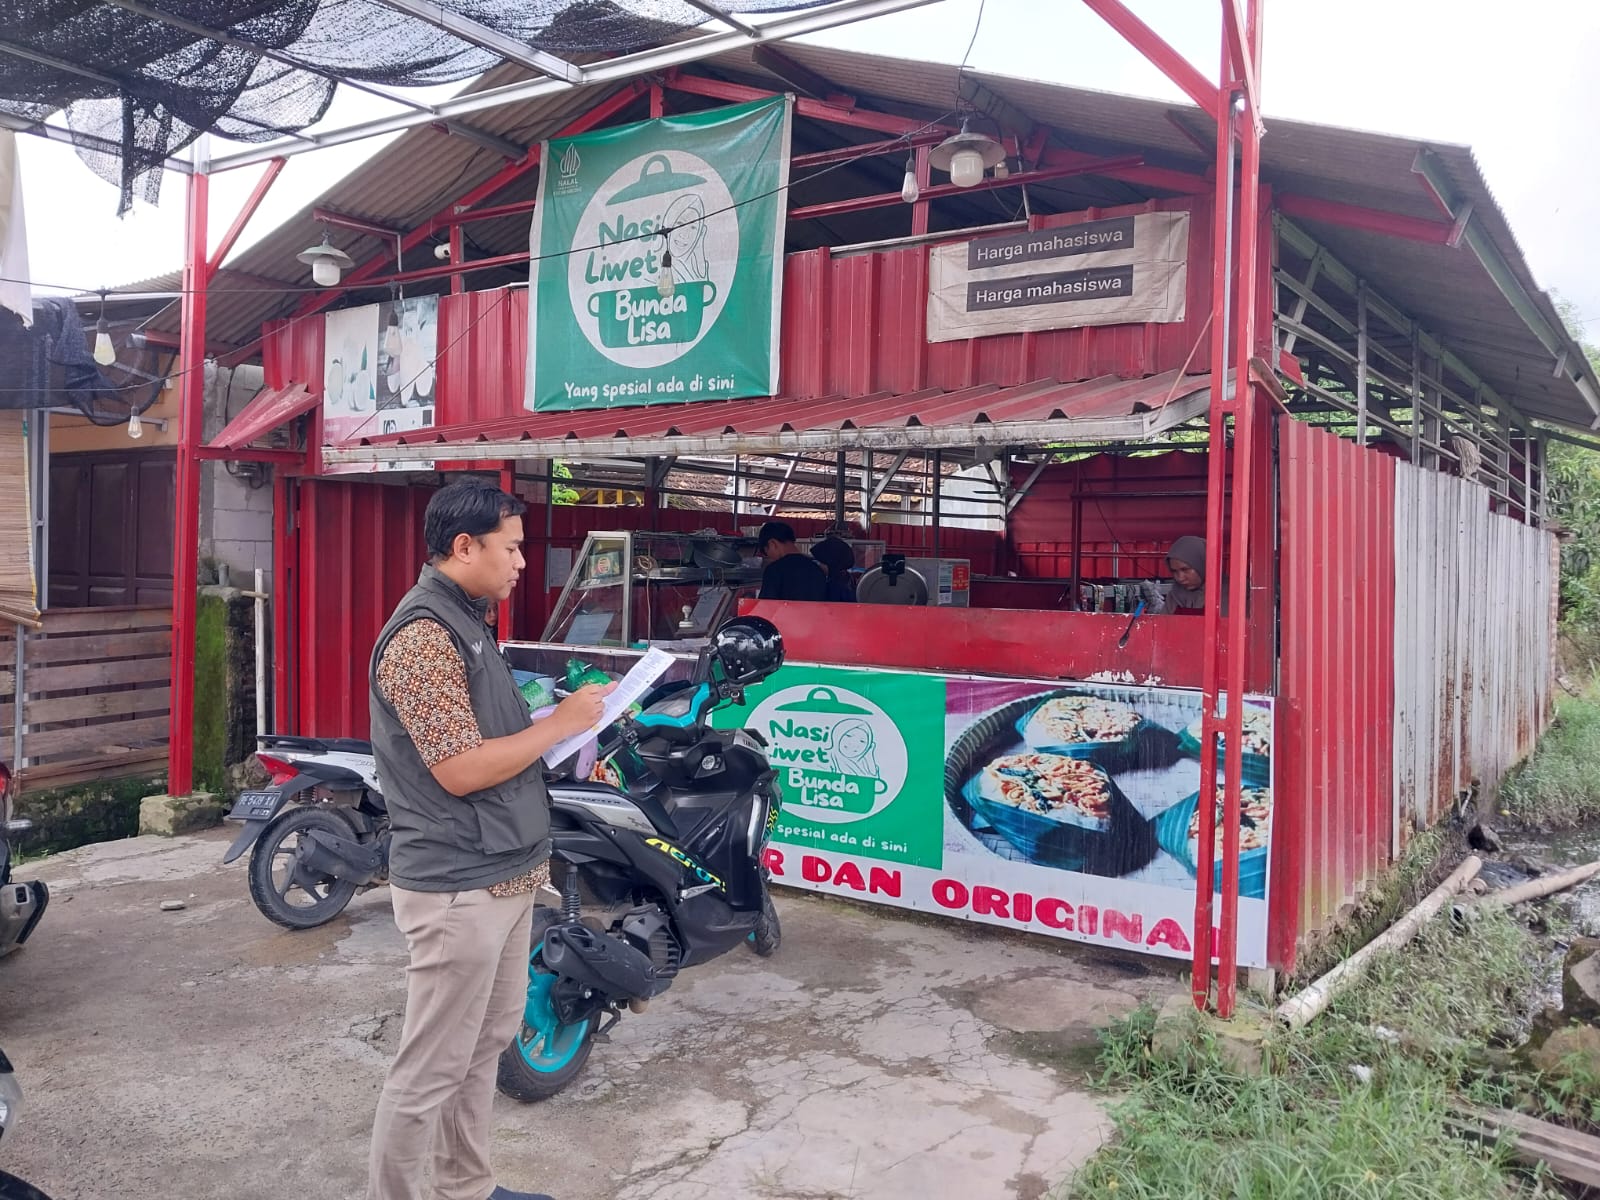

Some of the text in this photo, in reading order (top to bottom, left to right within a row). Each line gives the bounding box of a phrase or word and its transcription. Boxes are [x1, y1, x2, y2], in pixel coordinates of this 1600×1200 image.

[599, 214, 661, 249] Nasi
[977, 231, 1123, 261] Harga mahasiswa
[585, 252, 659, 284] Liwet
[615, 289, 687, 321] Bunda
[976, 278, 1121, 303] Harga mahasiswa
[627, 314, 671, 345] Lisa
[564, 374, 735, 401] Yang spesial ada di sini
[769, 718, 830, 743] Nasi
[769, 743, 830, 764] iwet
[788, 767, 859, 794] Bunda
[800, 786, 844, 808] Lisa
[777, 824, 908, 854] spesial ada di sini
[801, 854, 902, 898] DAN
[931, 878, 1221, 959] ORIGINA
